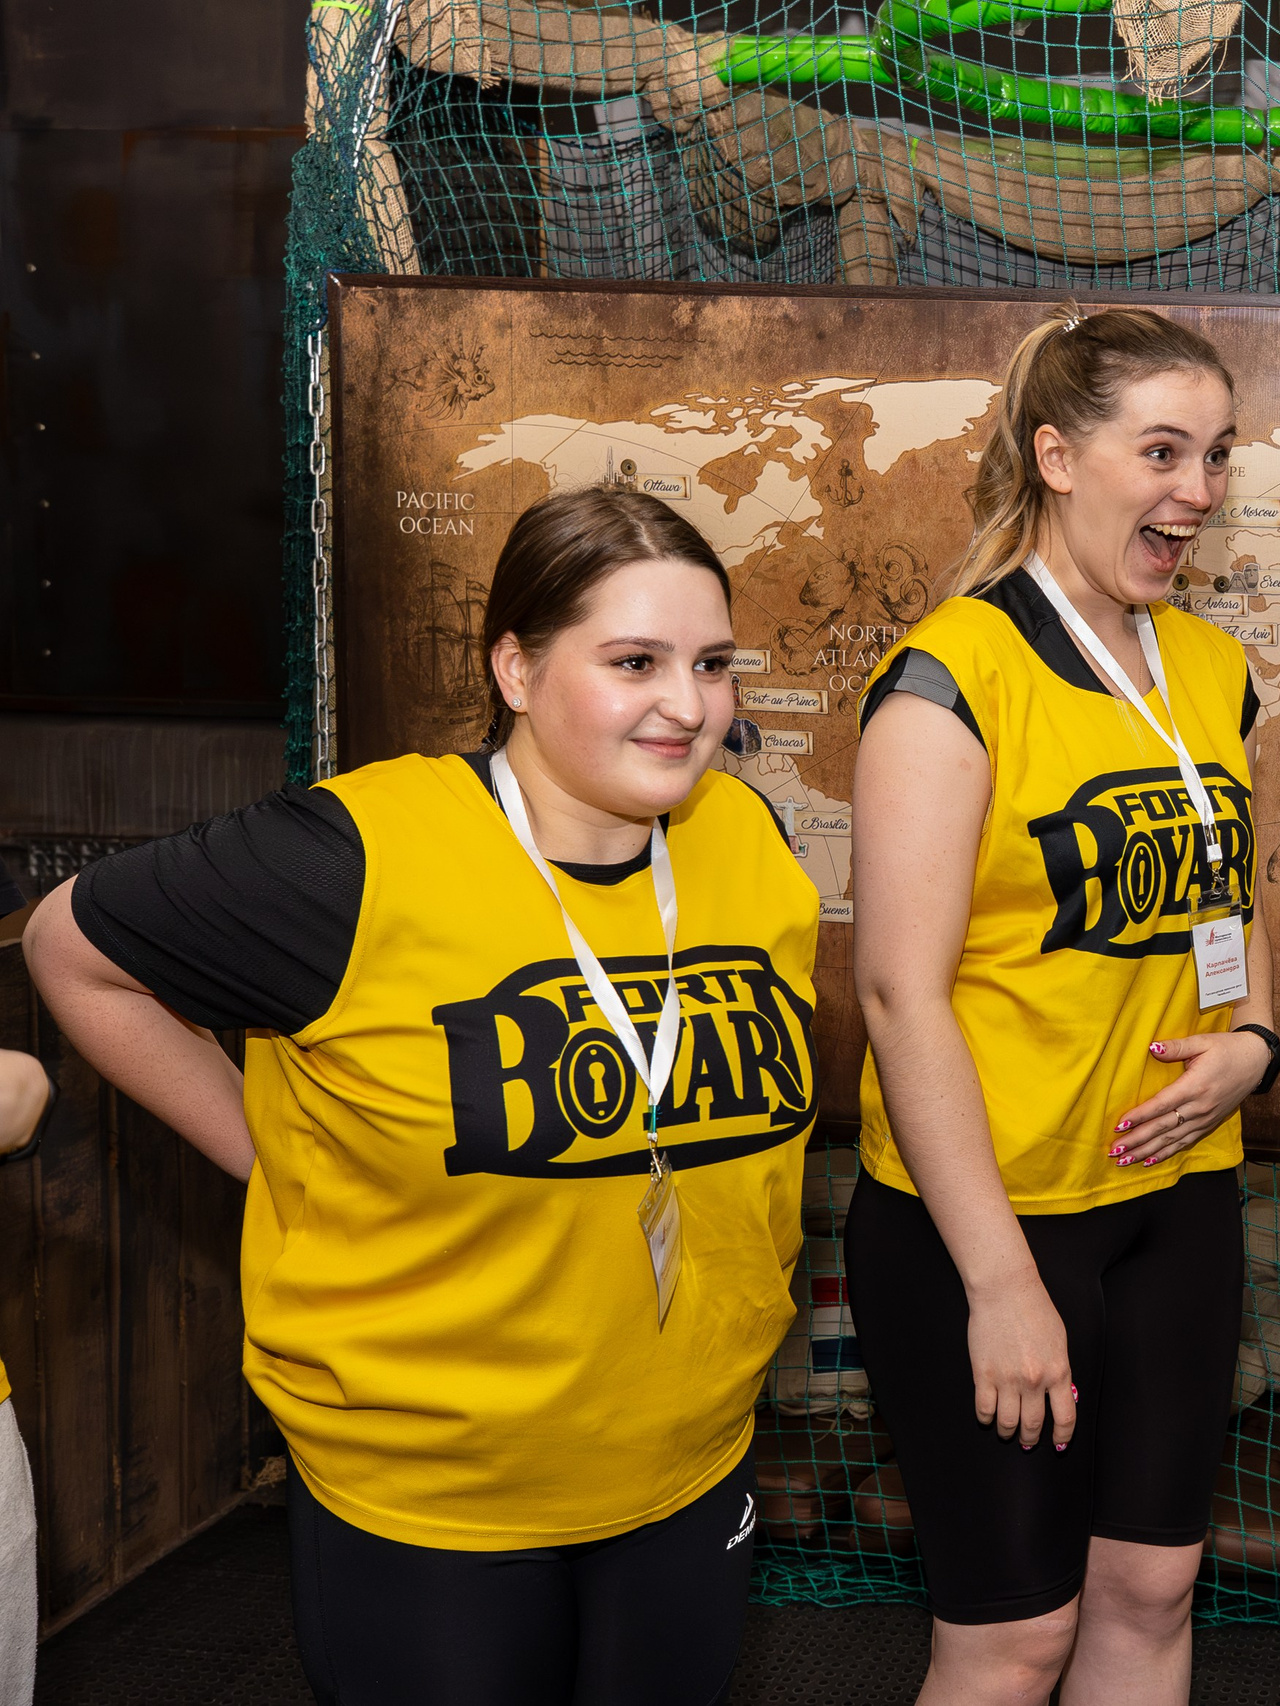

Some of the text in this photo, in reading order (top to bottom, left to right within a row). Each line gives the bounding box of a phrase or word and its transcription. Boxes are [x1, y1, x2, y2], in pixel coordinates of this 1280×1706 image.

[643, 479, 682, 492] Ottawa
[396, 491, 476, 511] PACIFIC
[1230, 505, 1280, 518] Moscow
[399, 516, 475, 536] OCEAN
[1195, 597, 1242, 611] Ankara
[830, 624, 907, 643] NORTH
[1240, 627, 1271, 641] Aviv
[731, 655, 764, 667] avana
[744, 690, 819, 707] Port-au-Prince
[763, 734, 806, 748] Caracas
[1113, 785, 1225, 827] FORT
[819, 902, 852, 916] Buenos
[560, 968, 741, 1024] FORT
